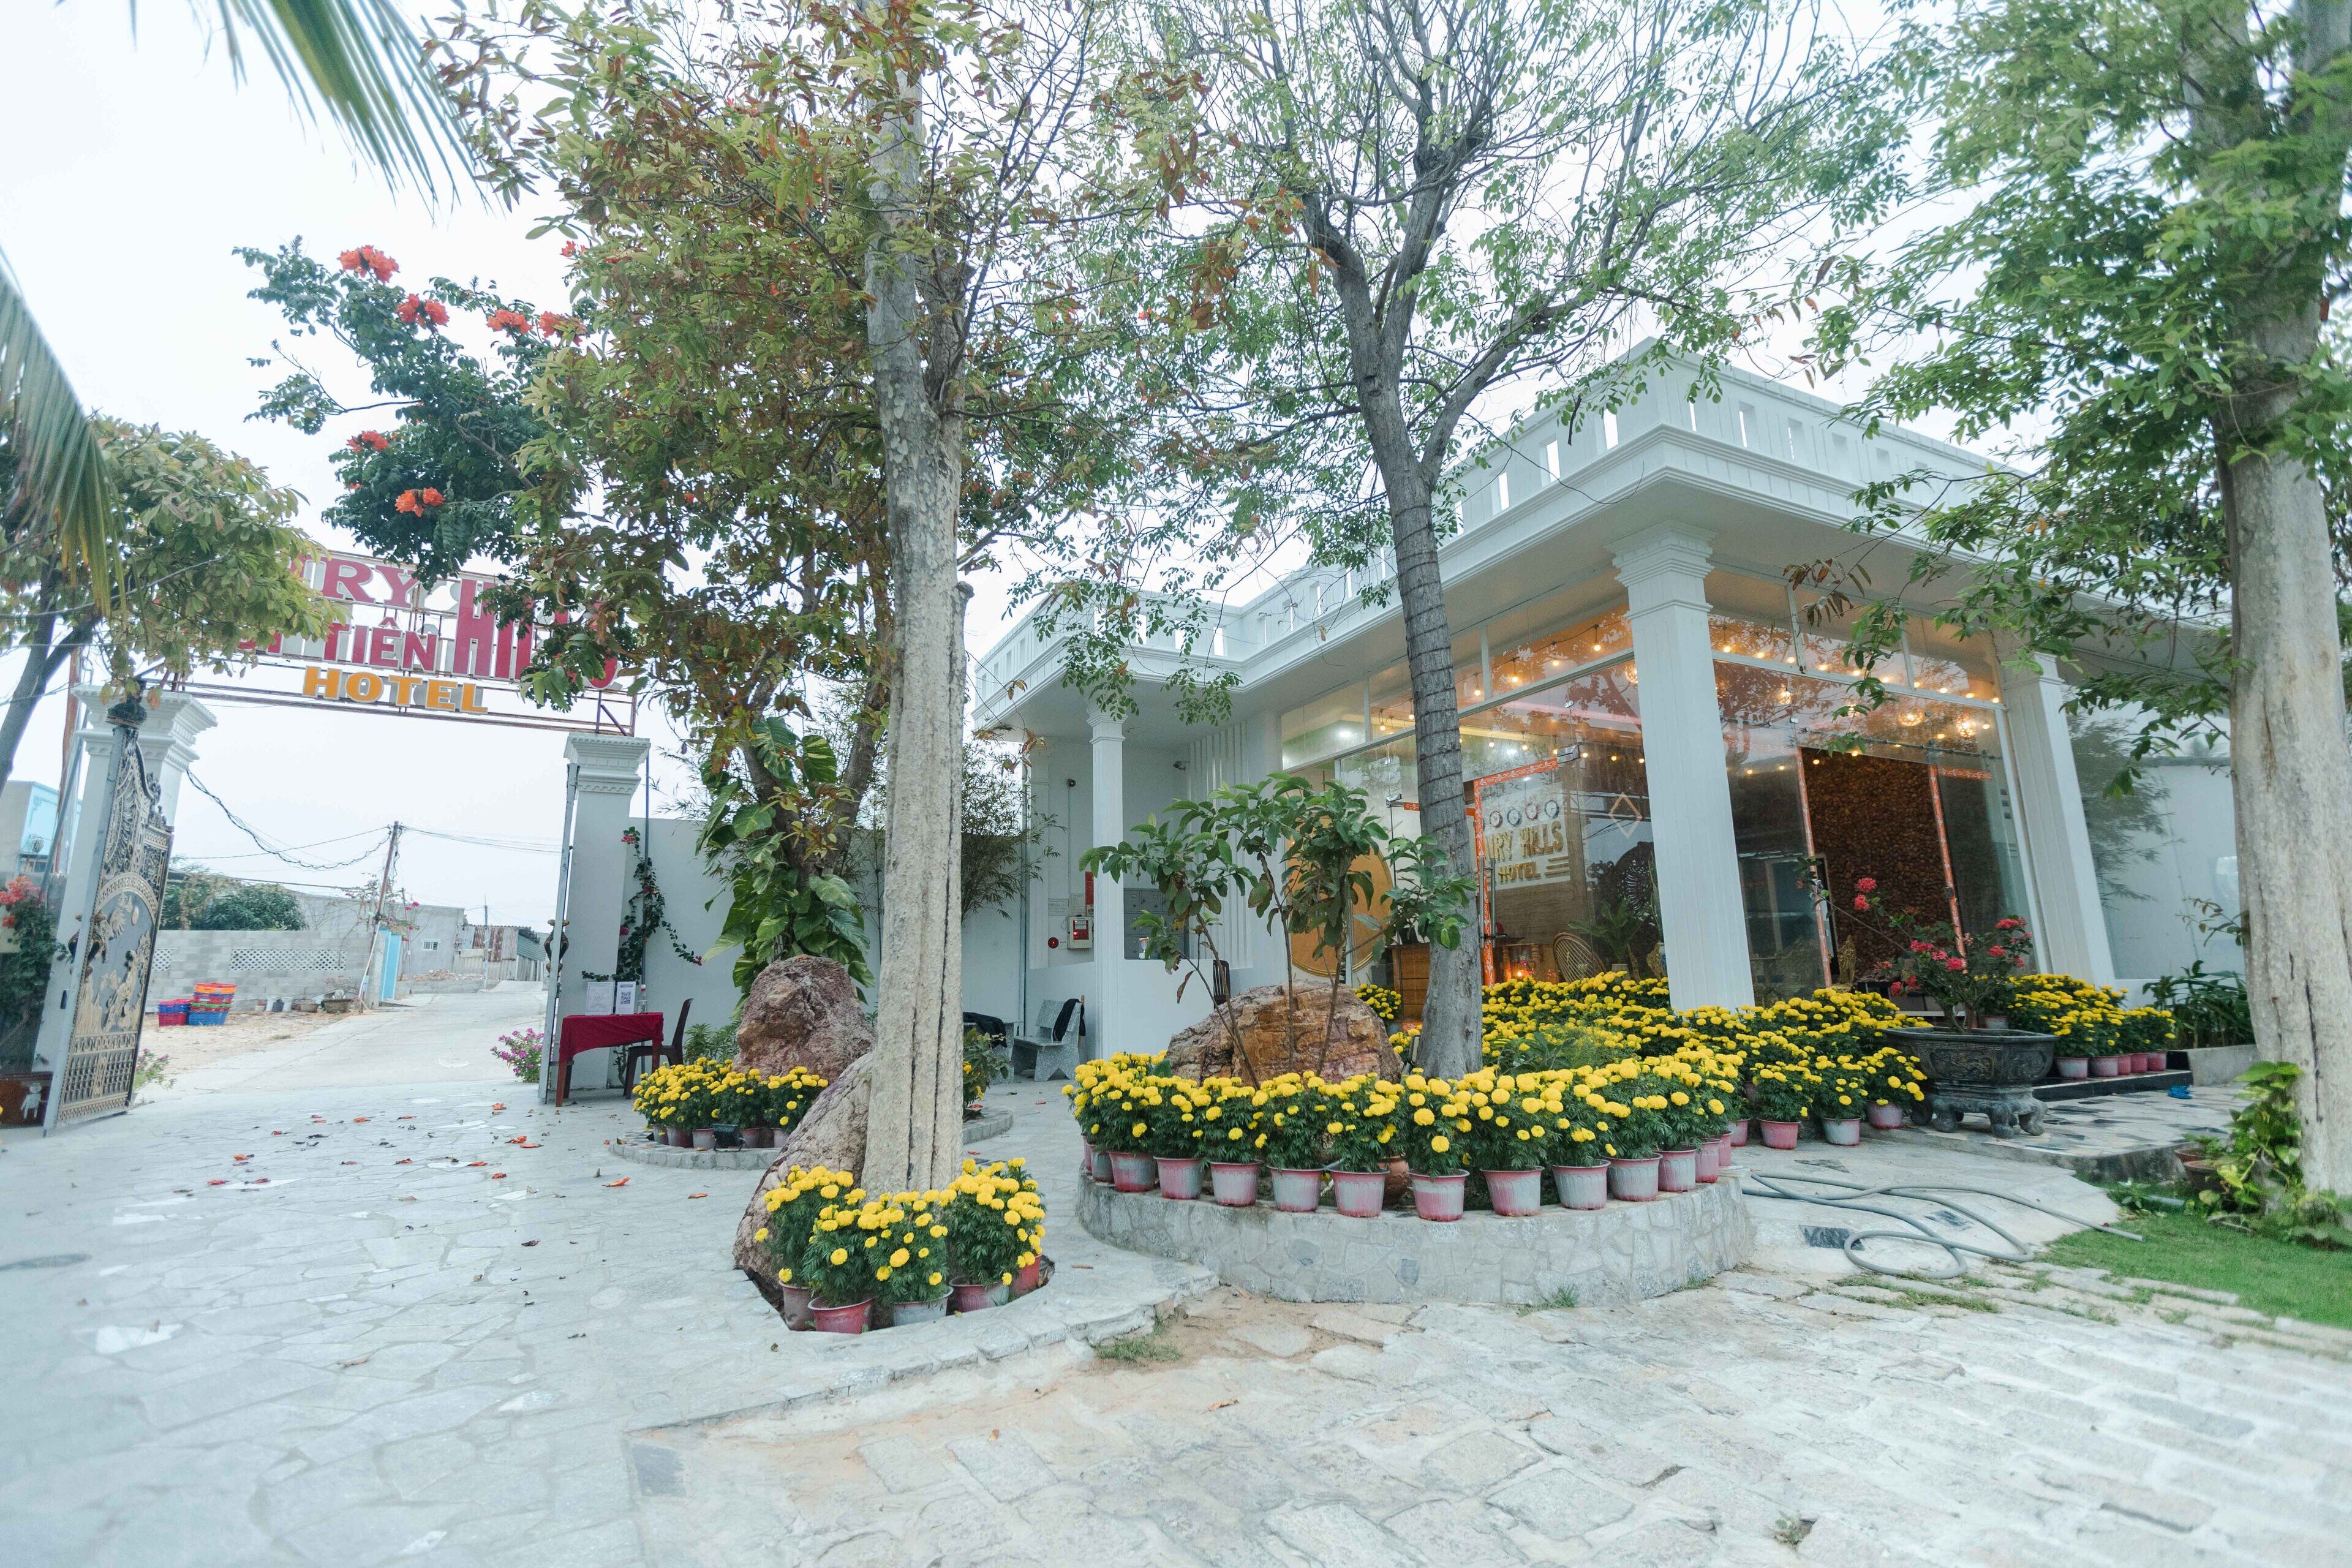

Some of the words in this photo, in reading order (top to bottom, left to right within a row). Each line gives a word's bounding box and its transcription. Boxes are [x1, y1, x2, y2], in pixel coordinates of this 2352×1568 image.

[302, 665, 489, 714] HOTEL
[1519, 820, 1564, 858] HILLS
[1498, 861, 1542, 883] HOTEL
